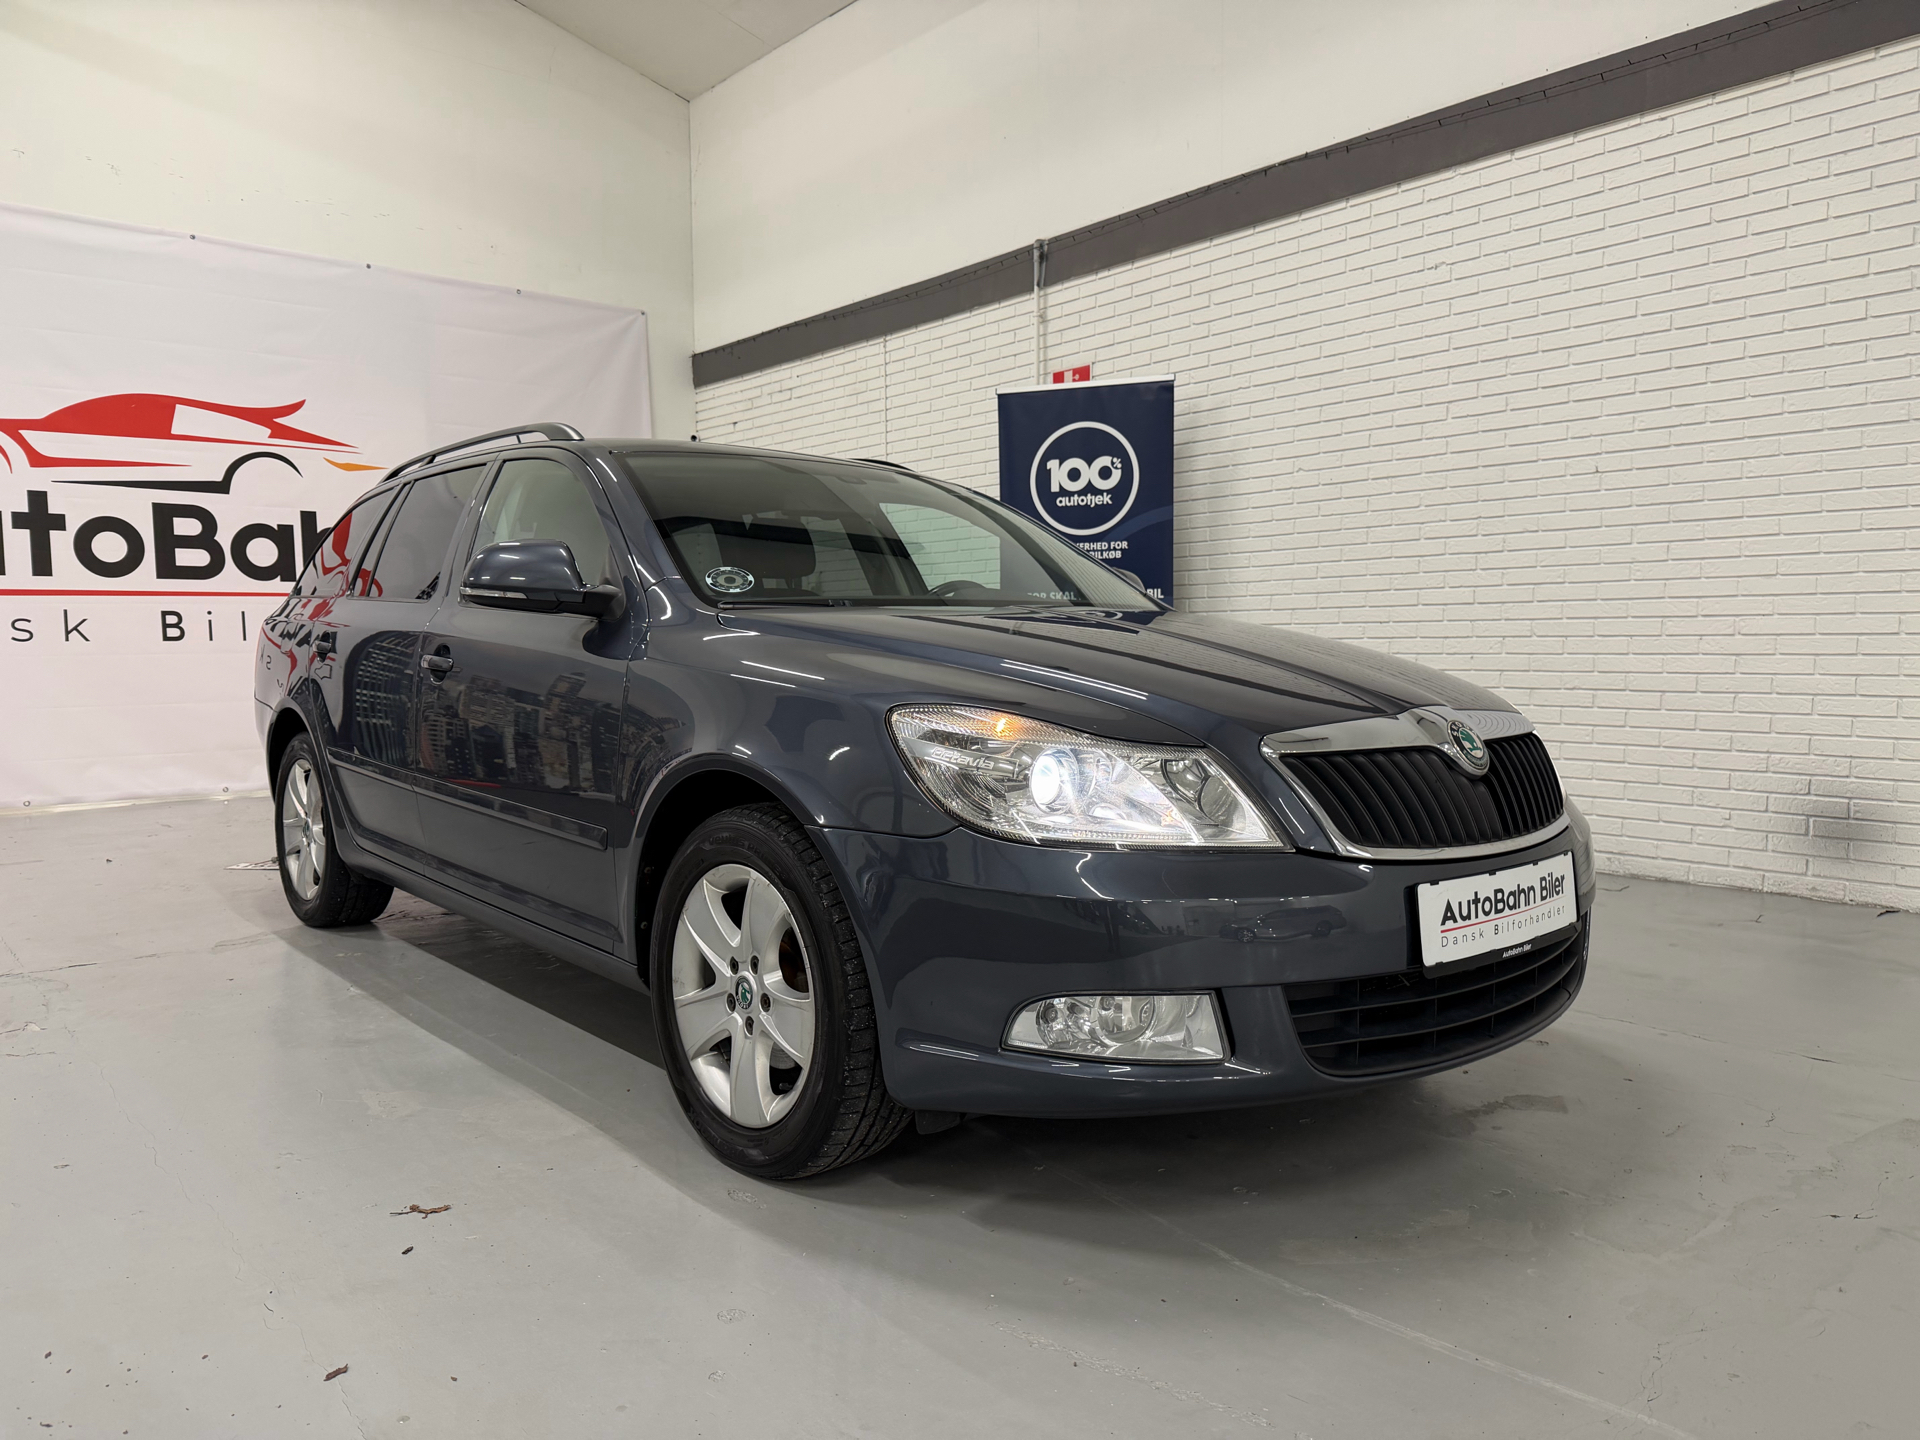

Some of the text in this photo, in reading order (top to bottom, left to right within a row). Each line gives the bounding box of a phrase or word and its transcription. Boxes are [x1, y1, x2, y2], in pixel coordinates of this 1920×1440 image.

[1046, 455, 1122, 493] 100%
[1056, 492, 1113, 508] autotjek
[1076, 540, 1129, 551] ERHED FOR
[1440, 871, 1566, 926] AutoBahn Biler
[1441, 905, 1566, 948] Dansk Bilforhandler
[1502, 946, 1524, 958] AutoBahn
